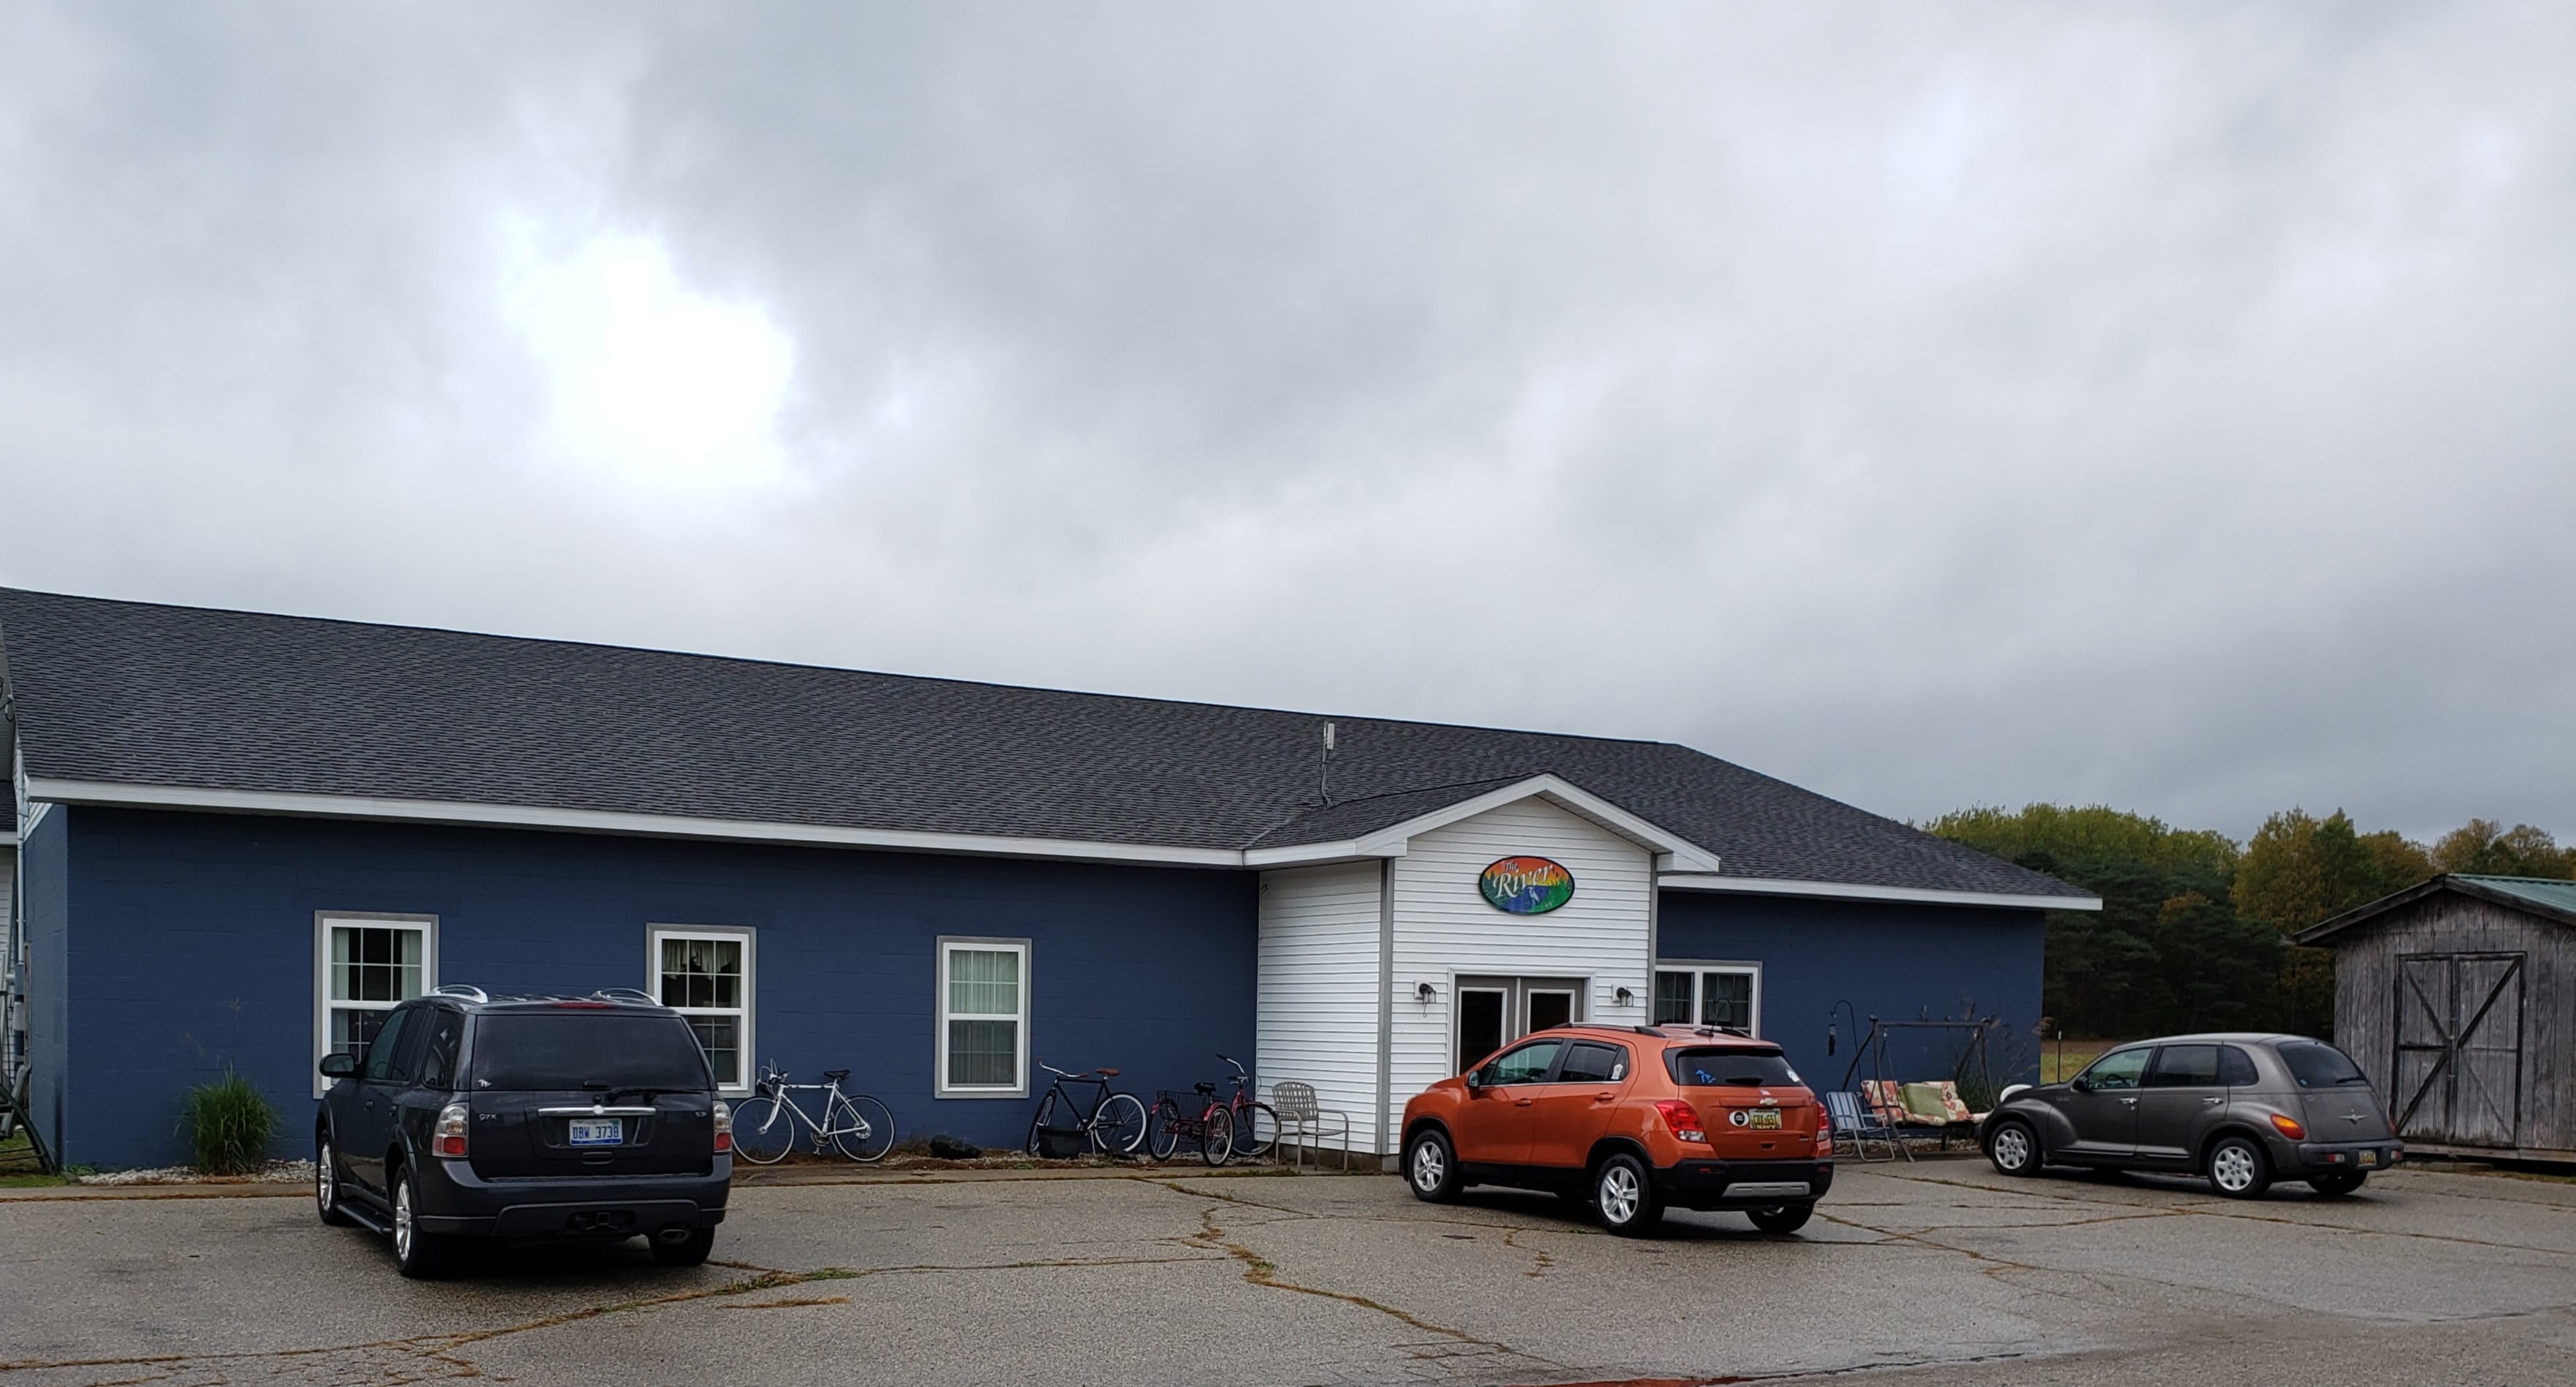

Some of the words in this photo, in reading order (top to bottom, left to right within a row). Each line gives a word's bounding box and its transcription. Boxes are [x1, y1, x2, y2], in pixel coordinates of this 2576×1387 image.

[1506, 861, 1518, 872] The
[1492, 864, 1554, 899] River
[596, 1126, 619, 1138] 3738
